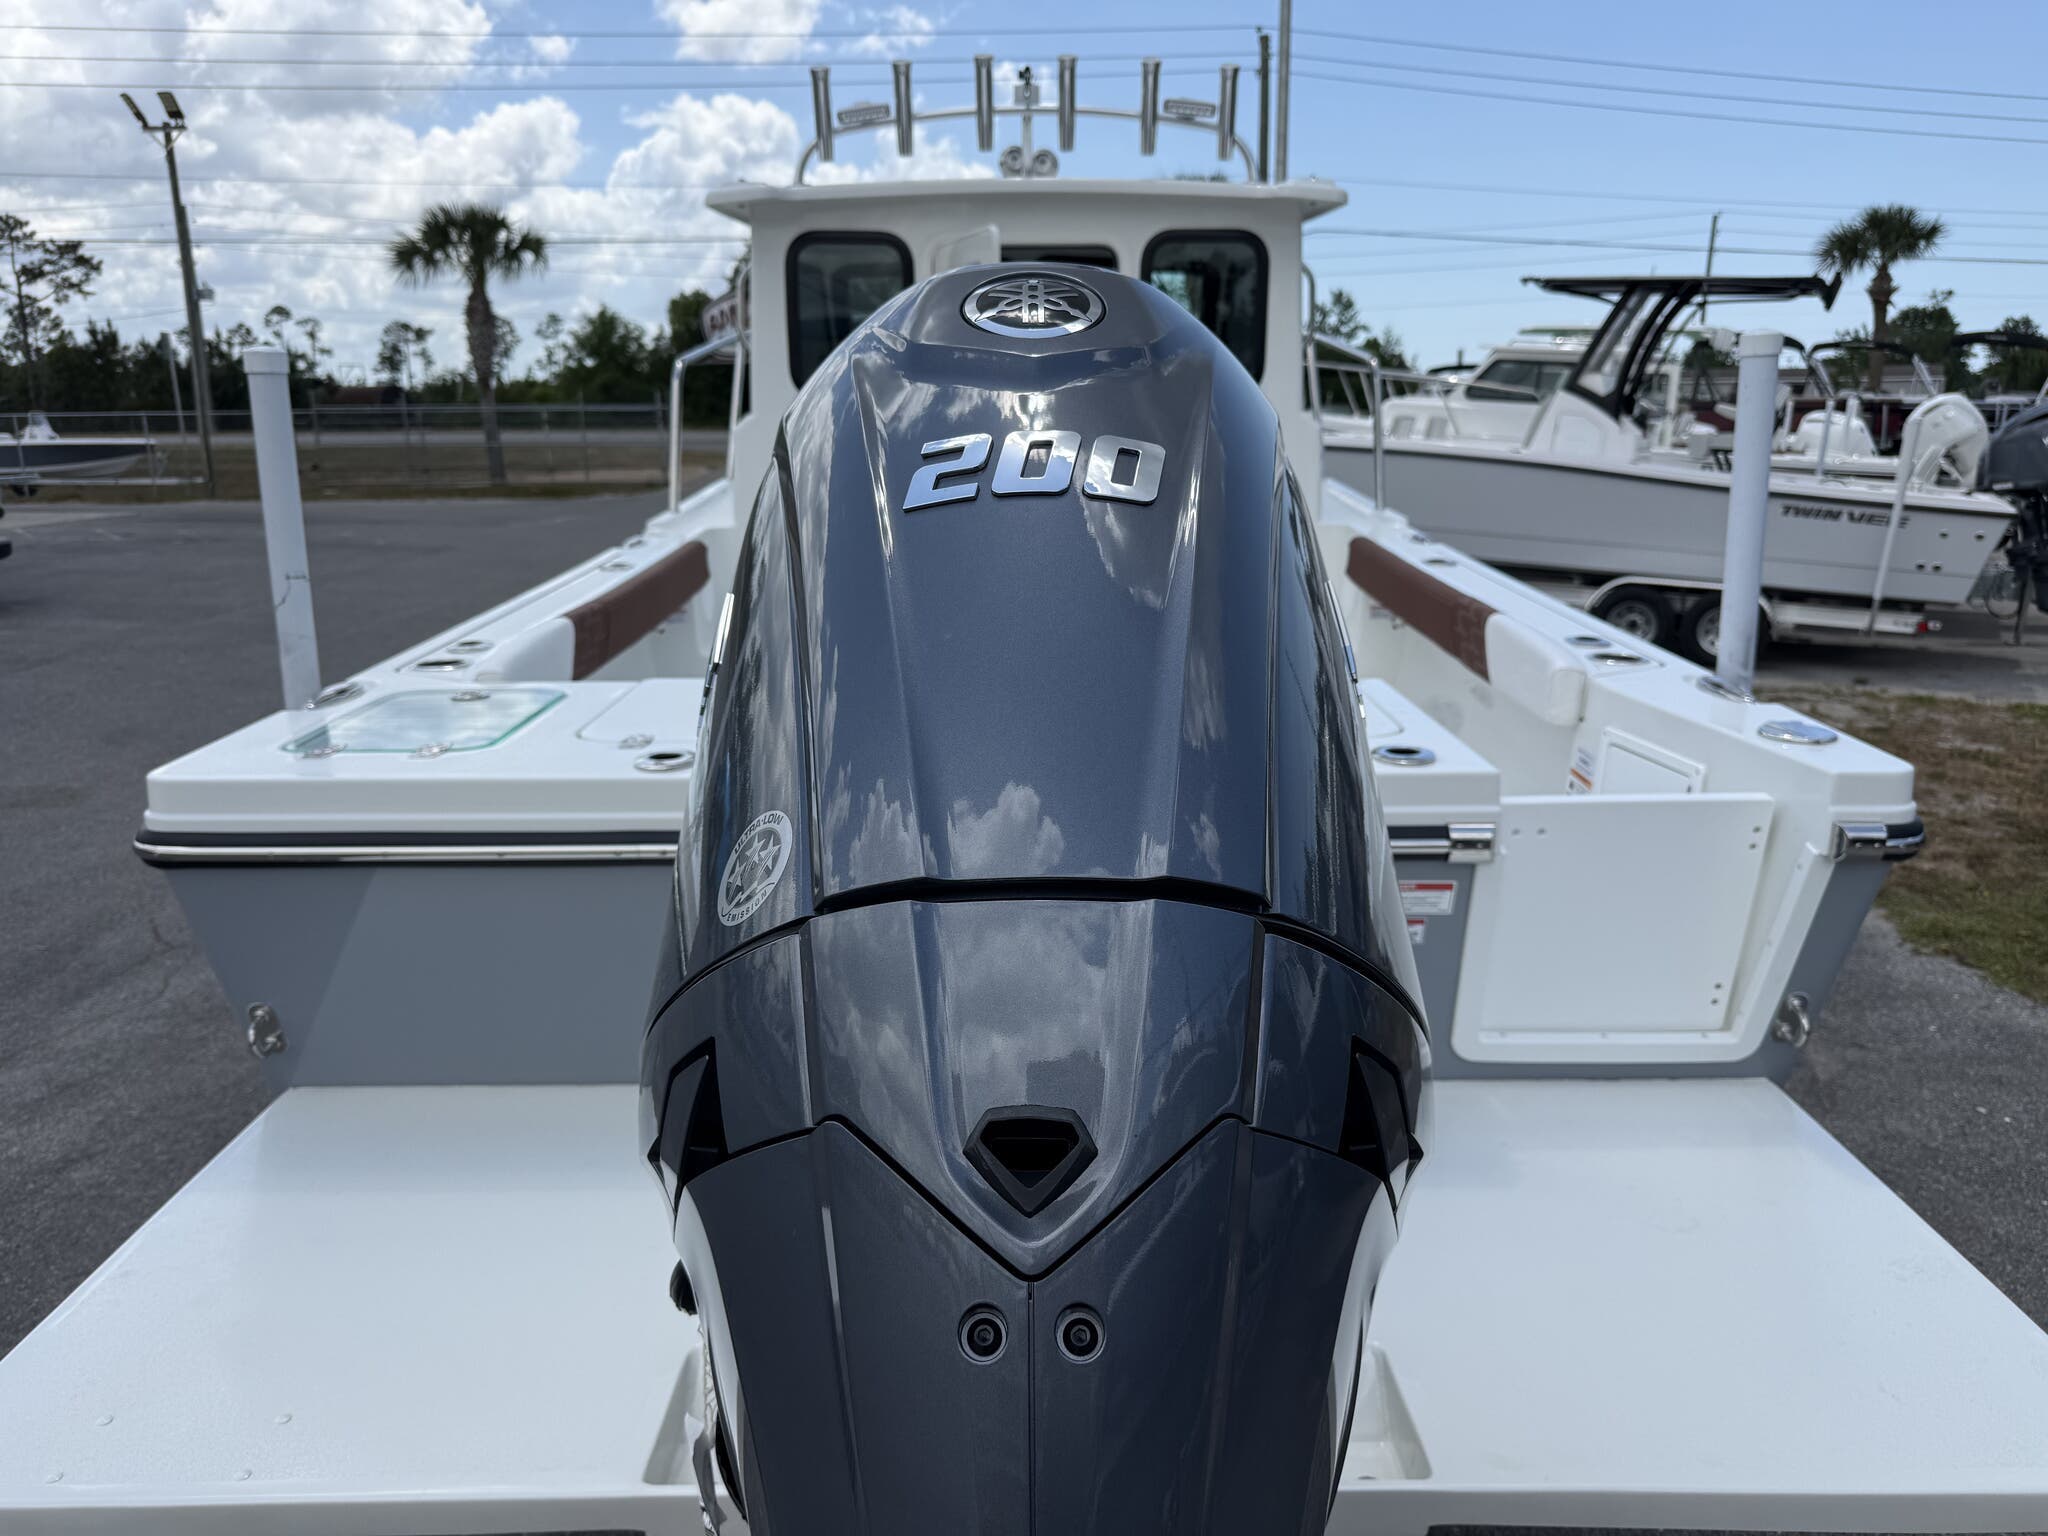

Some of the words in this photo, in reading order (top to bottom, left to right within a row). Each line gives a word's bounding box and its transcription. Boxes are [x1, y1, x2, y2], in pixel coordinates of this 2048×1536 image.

[902, 430, 1167, 512] 200
[1782, 505, 1841, 521] TWIN
[726, 890, 769, 922] EMISSION
